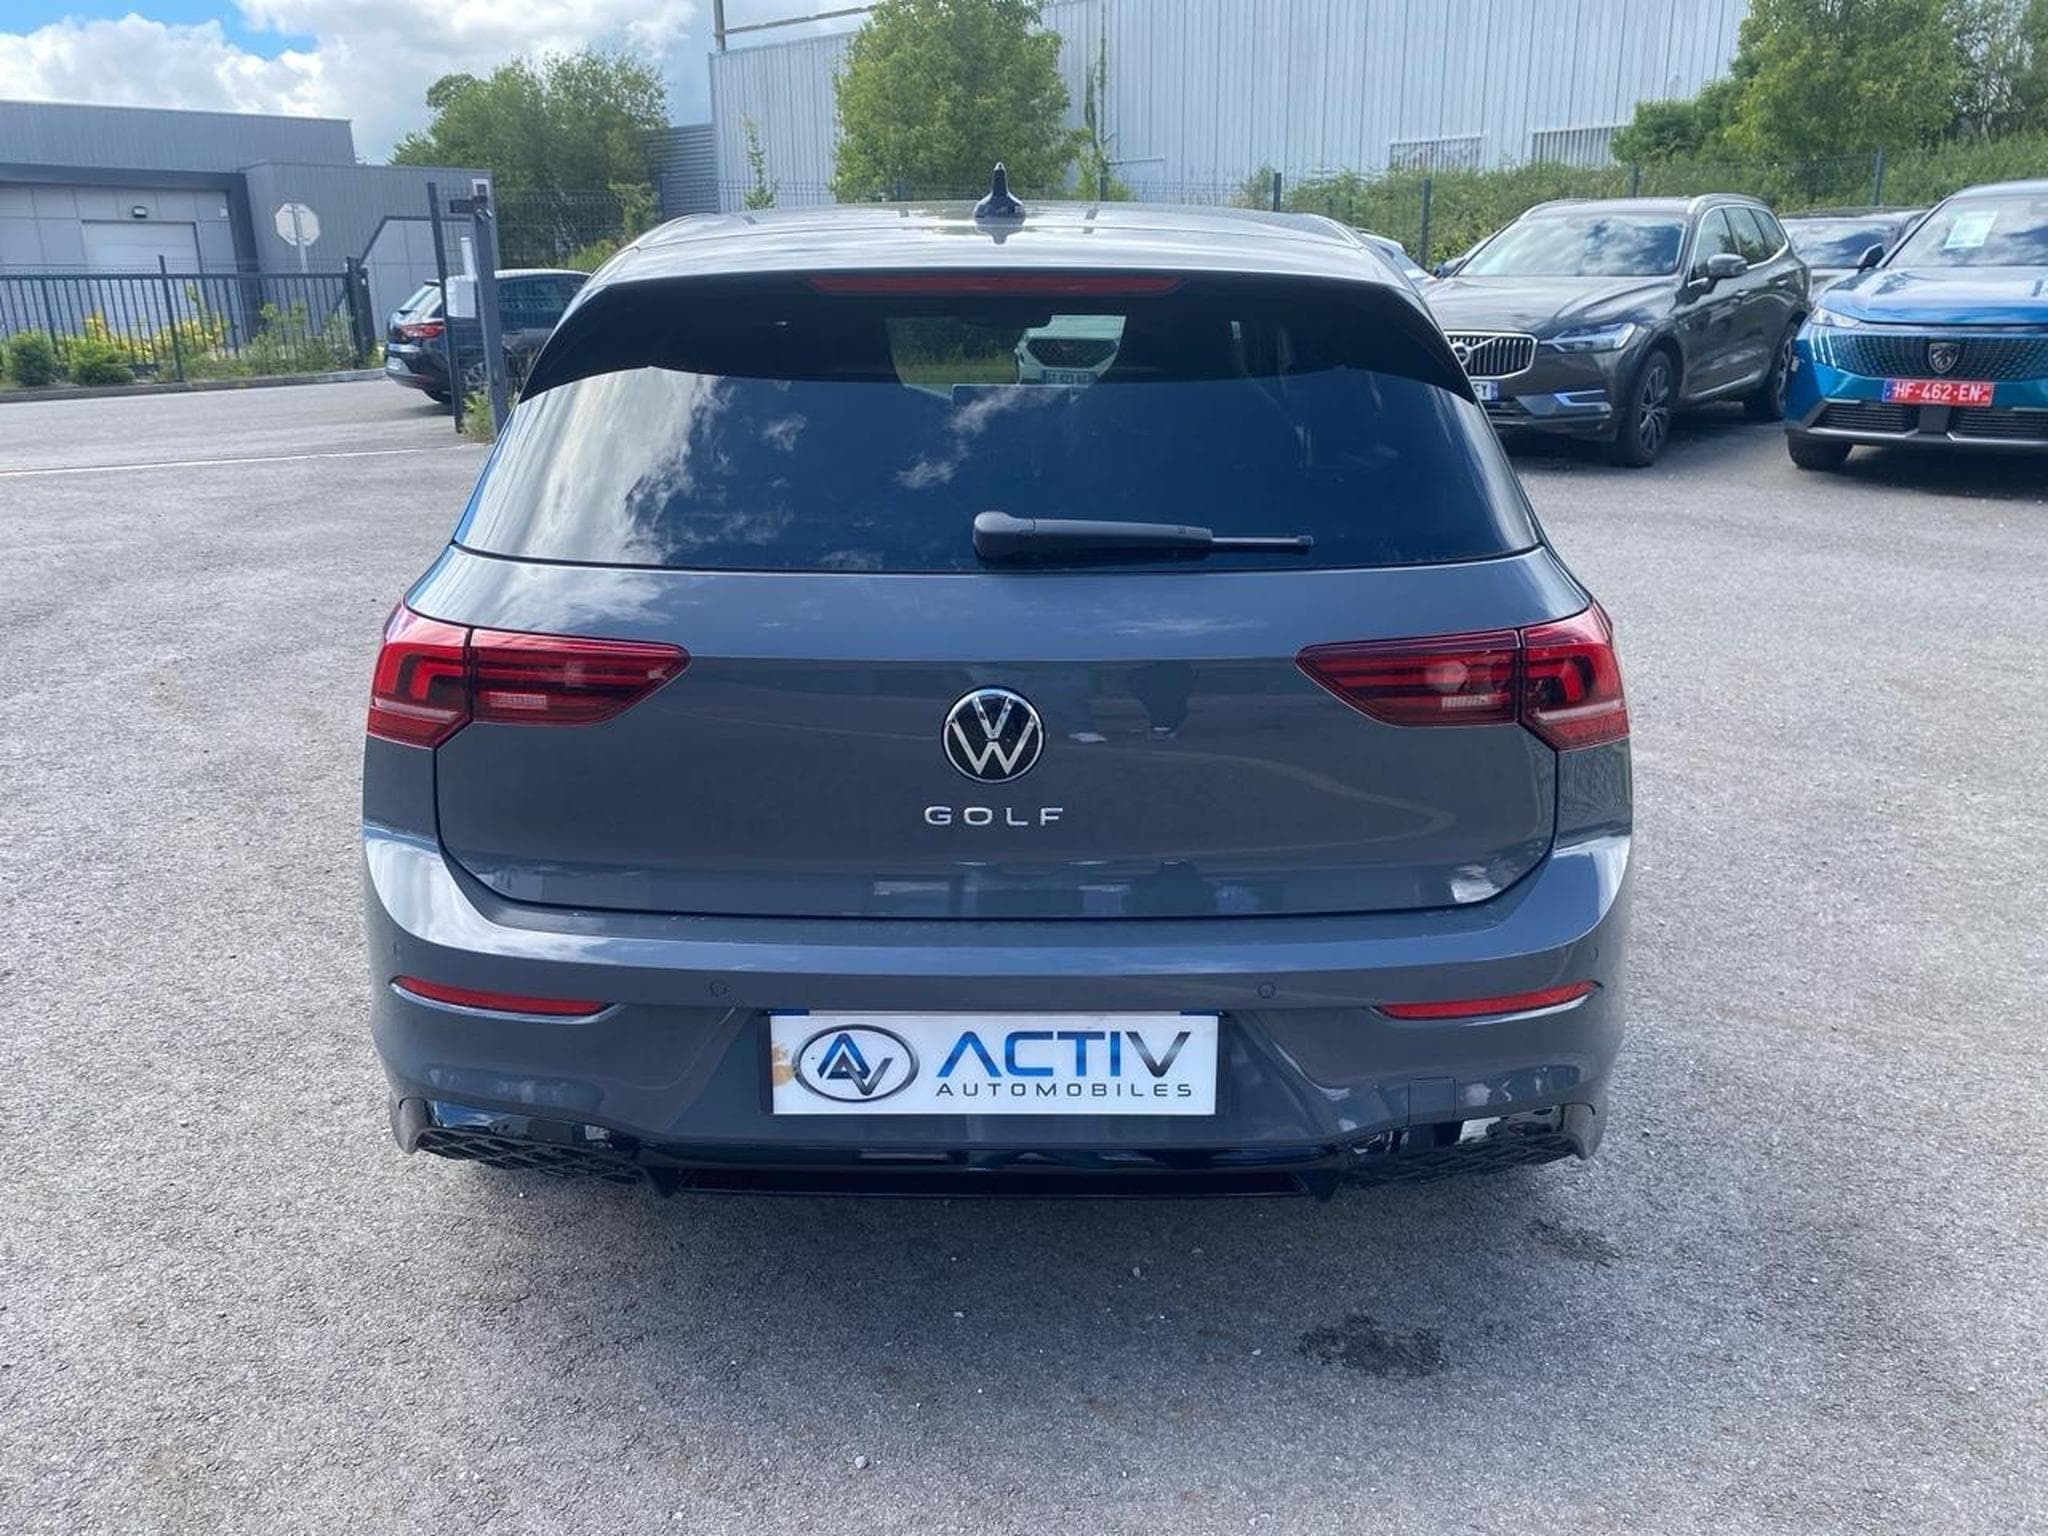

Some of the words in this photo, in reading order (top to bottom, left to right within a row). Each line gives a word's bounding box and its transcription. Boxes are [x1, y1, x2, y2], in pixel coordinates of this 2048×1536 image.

[924, 805, 1064, 827] GOLF
[936, 1031, 1192, 1078] ACTIV
[936, 1083, 1192, 1097] AUTOMOBILES
